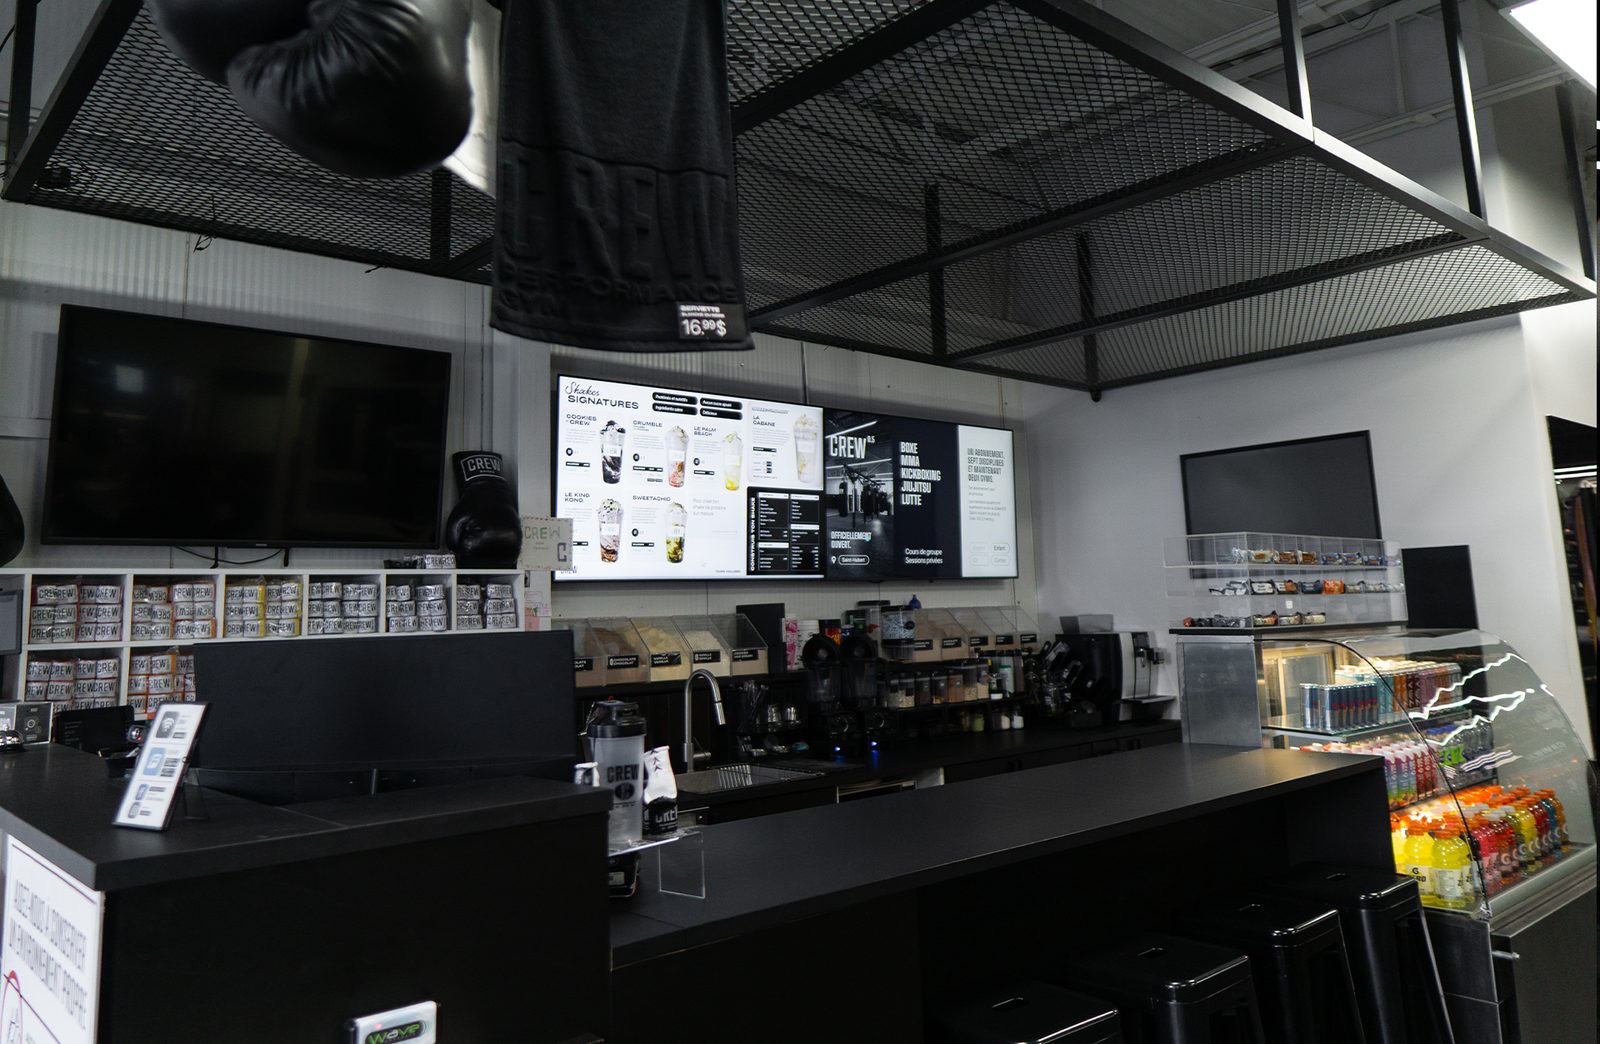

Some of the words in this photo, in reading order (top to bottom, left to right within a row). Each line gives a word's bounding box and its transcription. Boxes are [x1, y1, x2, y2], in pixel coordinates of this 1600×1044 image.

[682, 319, 726, 336] 16.99$
[568, 394, 639, 410] SIGNATURES
[830, 434, 866, 459] CREW
[900, 441, 918, 454] BOXE
[900, 454, 920, 467] MMA
[968, 456, 978, 464] SEPT
[901, 468, 942, 482] KICKBOXING
[968, 465, 974, 473] ET
[968, 474, 980, 482] DEUX
[901, 481, 932, 494] JIUJITSU
[902, 494, 922, 506] LUTTE
[926, 557, 944, 565] privées
[98, 607, 120, 618] CREW
[96, 625, 118, 637] CREW
[50, 664, 72, 676] CREW
[48, 684, 71, 694] CREW
[94, 682, 114, 692] CREW
